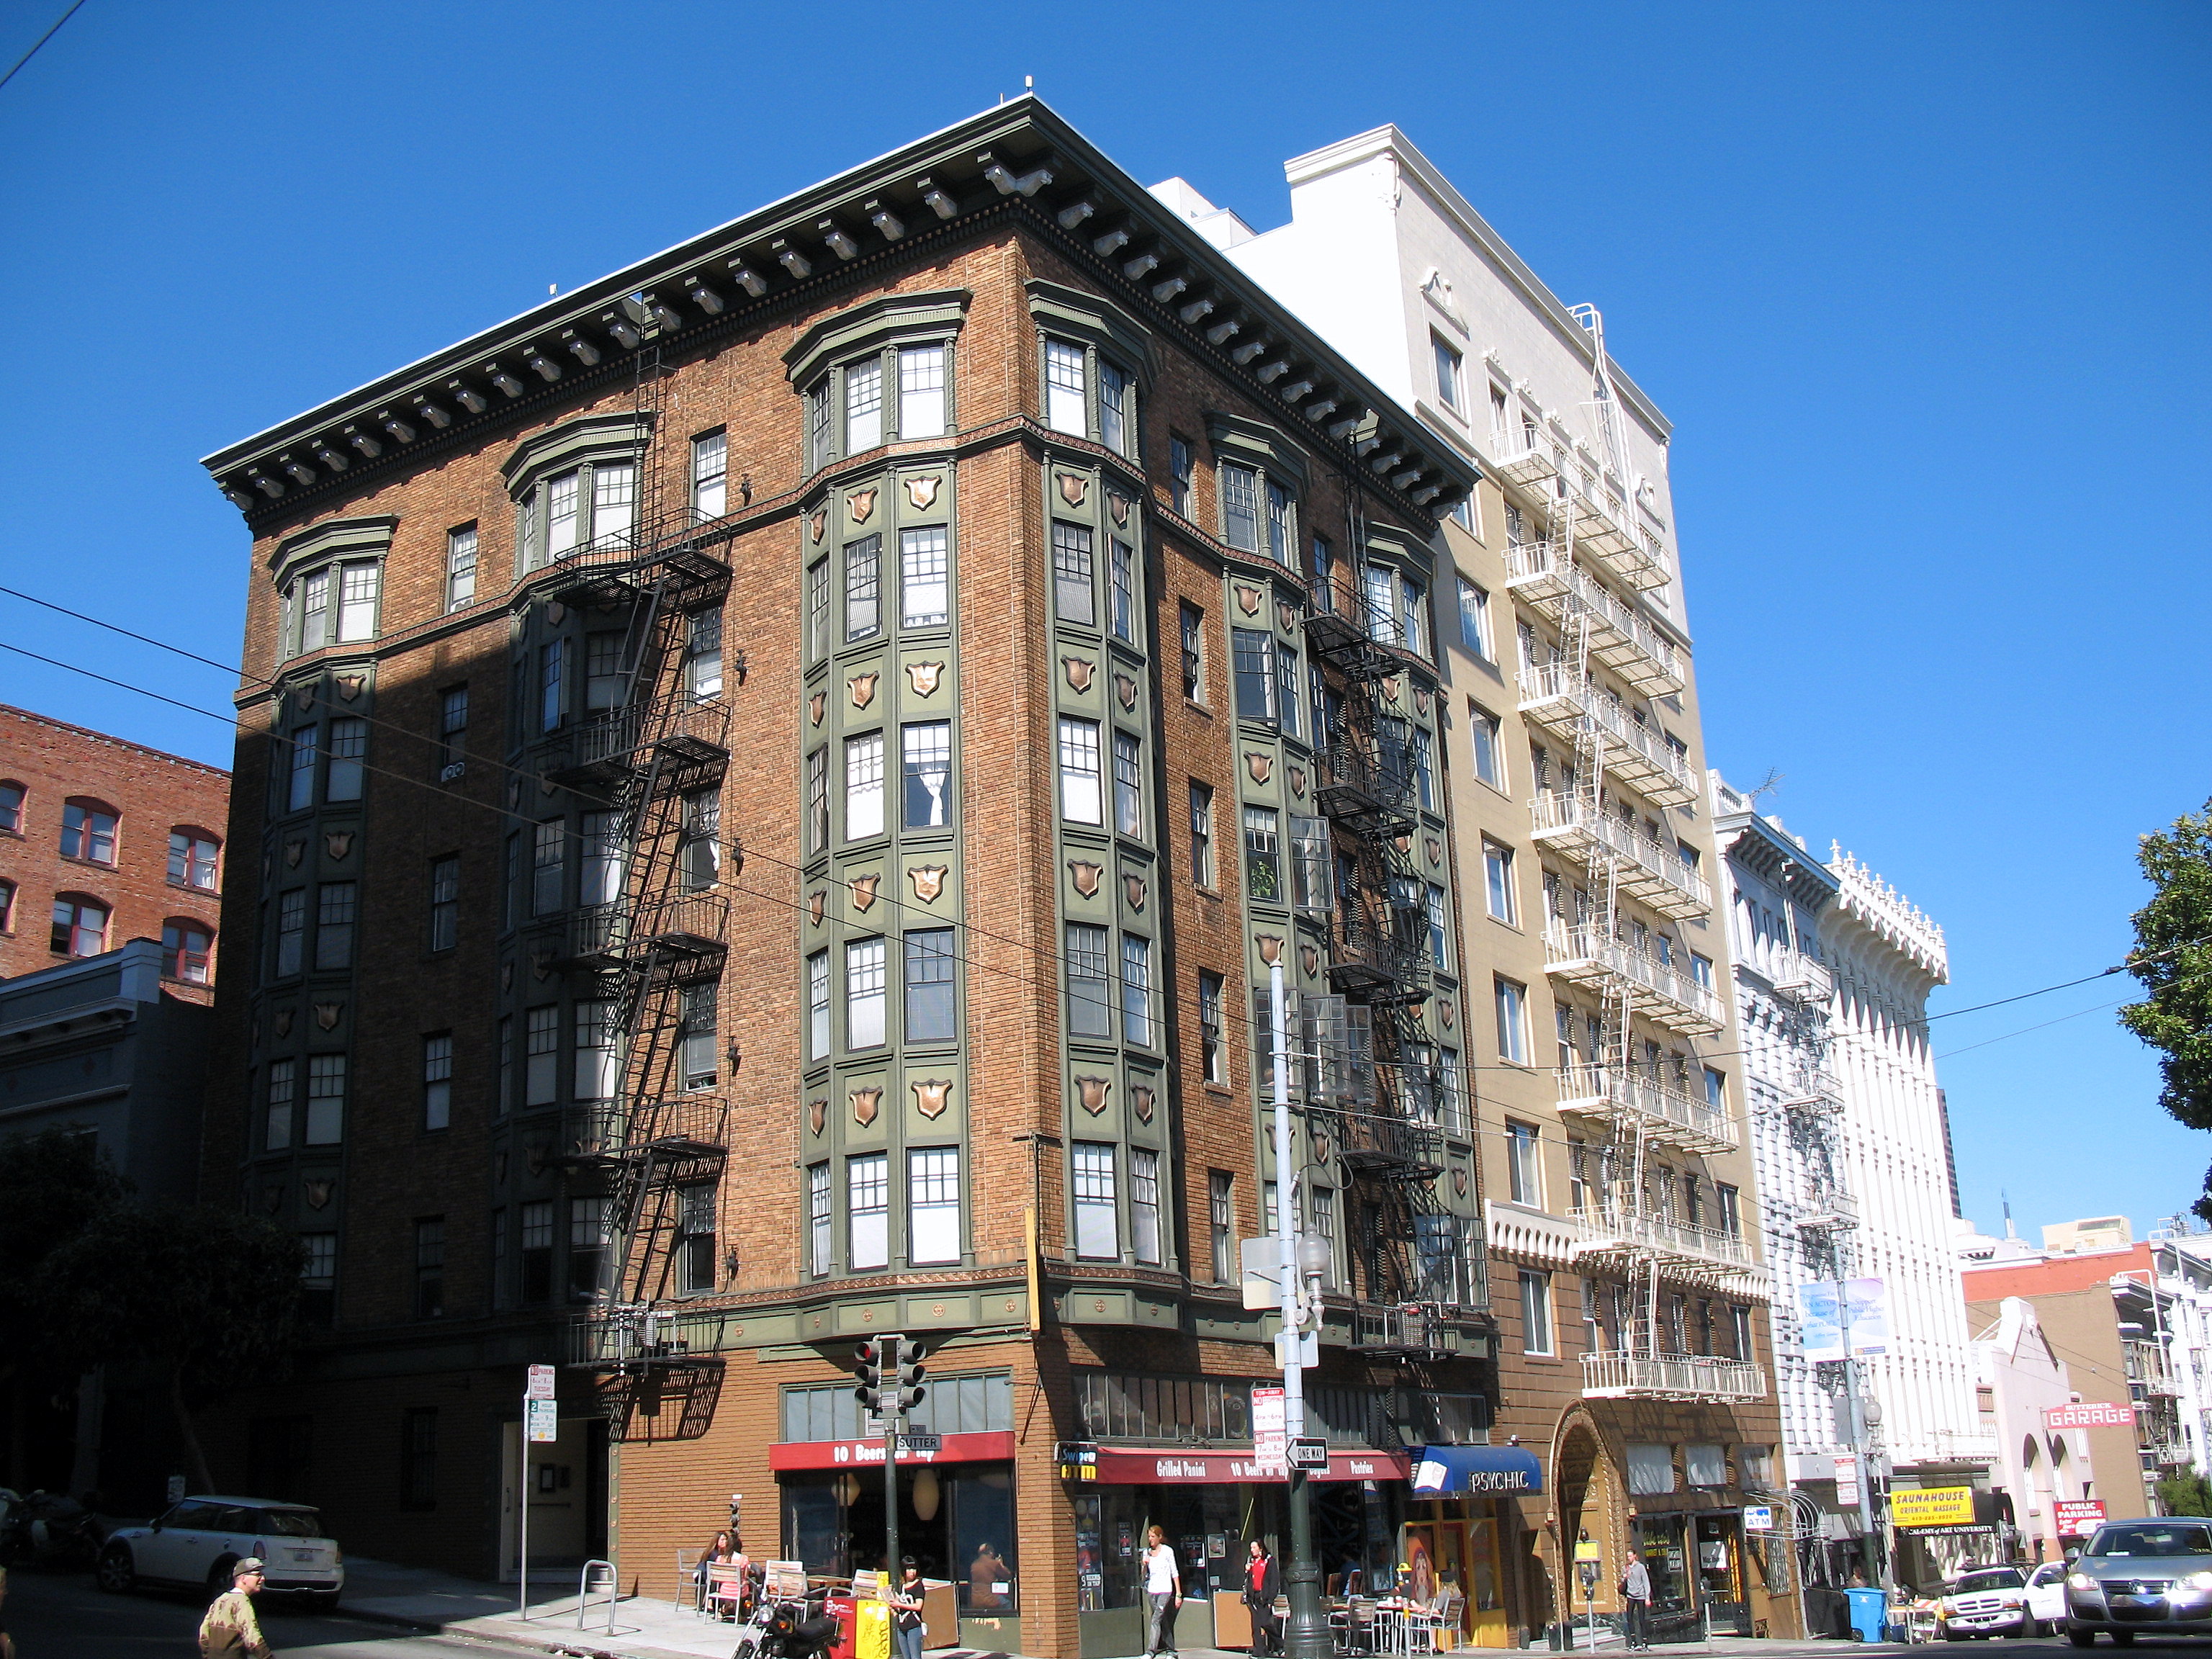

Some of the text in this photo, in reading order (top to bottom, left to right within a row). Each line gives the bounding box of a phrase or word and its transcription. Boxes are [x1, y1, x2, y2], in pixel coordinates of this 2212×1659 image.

[531, 1403, 537, 1411] 2
[2065, 1402, 2112, 1411] BUTTERICK
[2049, 1408, 2131, 1426] GARAGE
[899, 1437, 937, 1447] SUTTER
[1255, 1434, 1264, 1443] NO
[834, 1445, 849, 1463] 10
[855, 1444, 886, 1461] Beers
[1298, 1447, 1323, 1460] ONE WAY
[1156, 1460, 1206, 1477] Grilled Panini
[1231, 1462, 1241, 1477] 10
[1349, 1460, 1374, 1475] Pastries
[1470, 1470, 1529, 1492] PSYCHIC
[1896, 1491, 1964, 1504] SAUNAHOUSE
[1899, 1503, 1961, 1514] ORIENTAL MASSAGE
[2062, 1502, 2097, 1511] PUBLIC
[2057, 1509, 2103, 1519] PARKING
